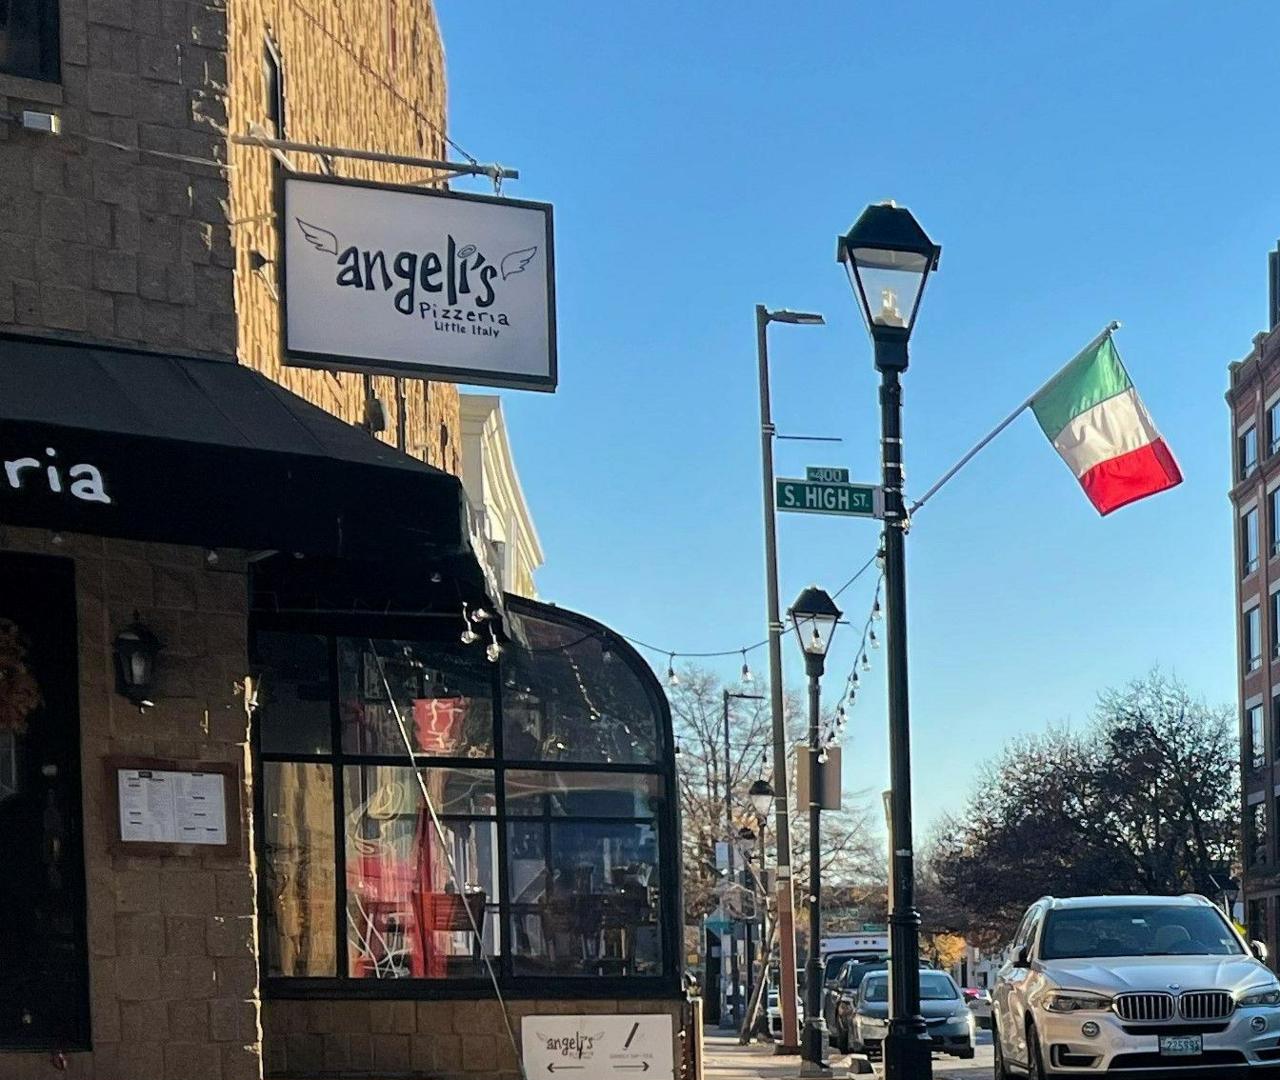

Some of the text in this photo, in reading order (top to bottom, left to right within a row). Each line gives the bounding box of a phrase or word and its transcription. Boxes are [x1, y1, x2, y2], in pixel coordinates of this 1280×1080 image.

[336, 234, 498, 315] angeli's
[419, 302, 510, 326] Pizzeria
[434, 321, 500, 338] Little Italy
[4, 447, 112, 504] ria
[815, 469, 843, 482] 400
[784, 485, 870, 510] S. HIGH ST.
